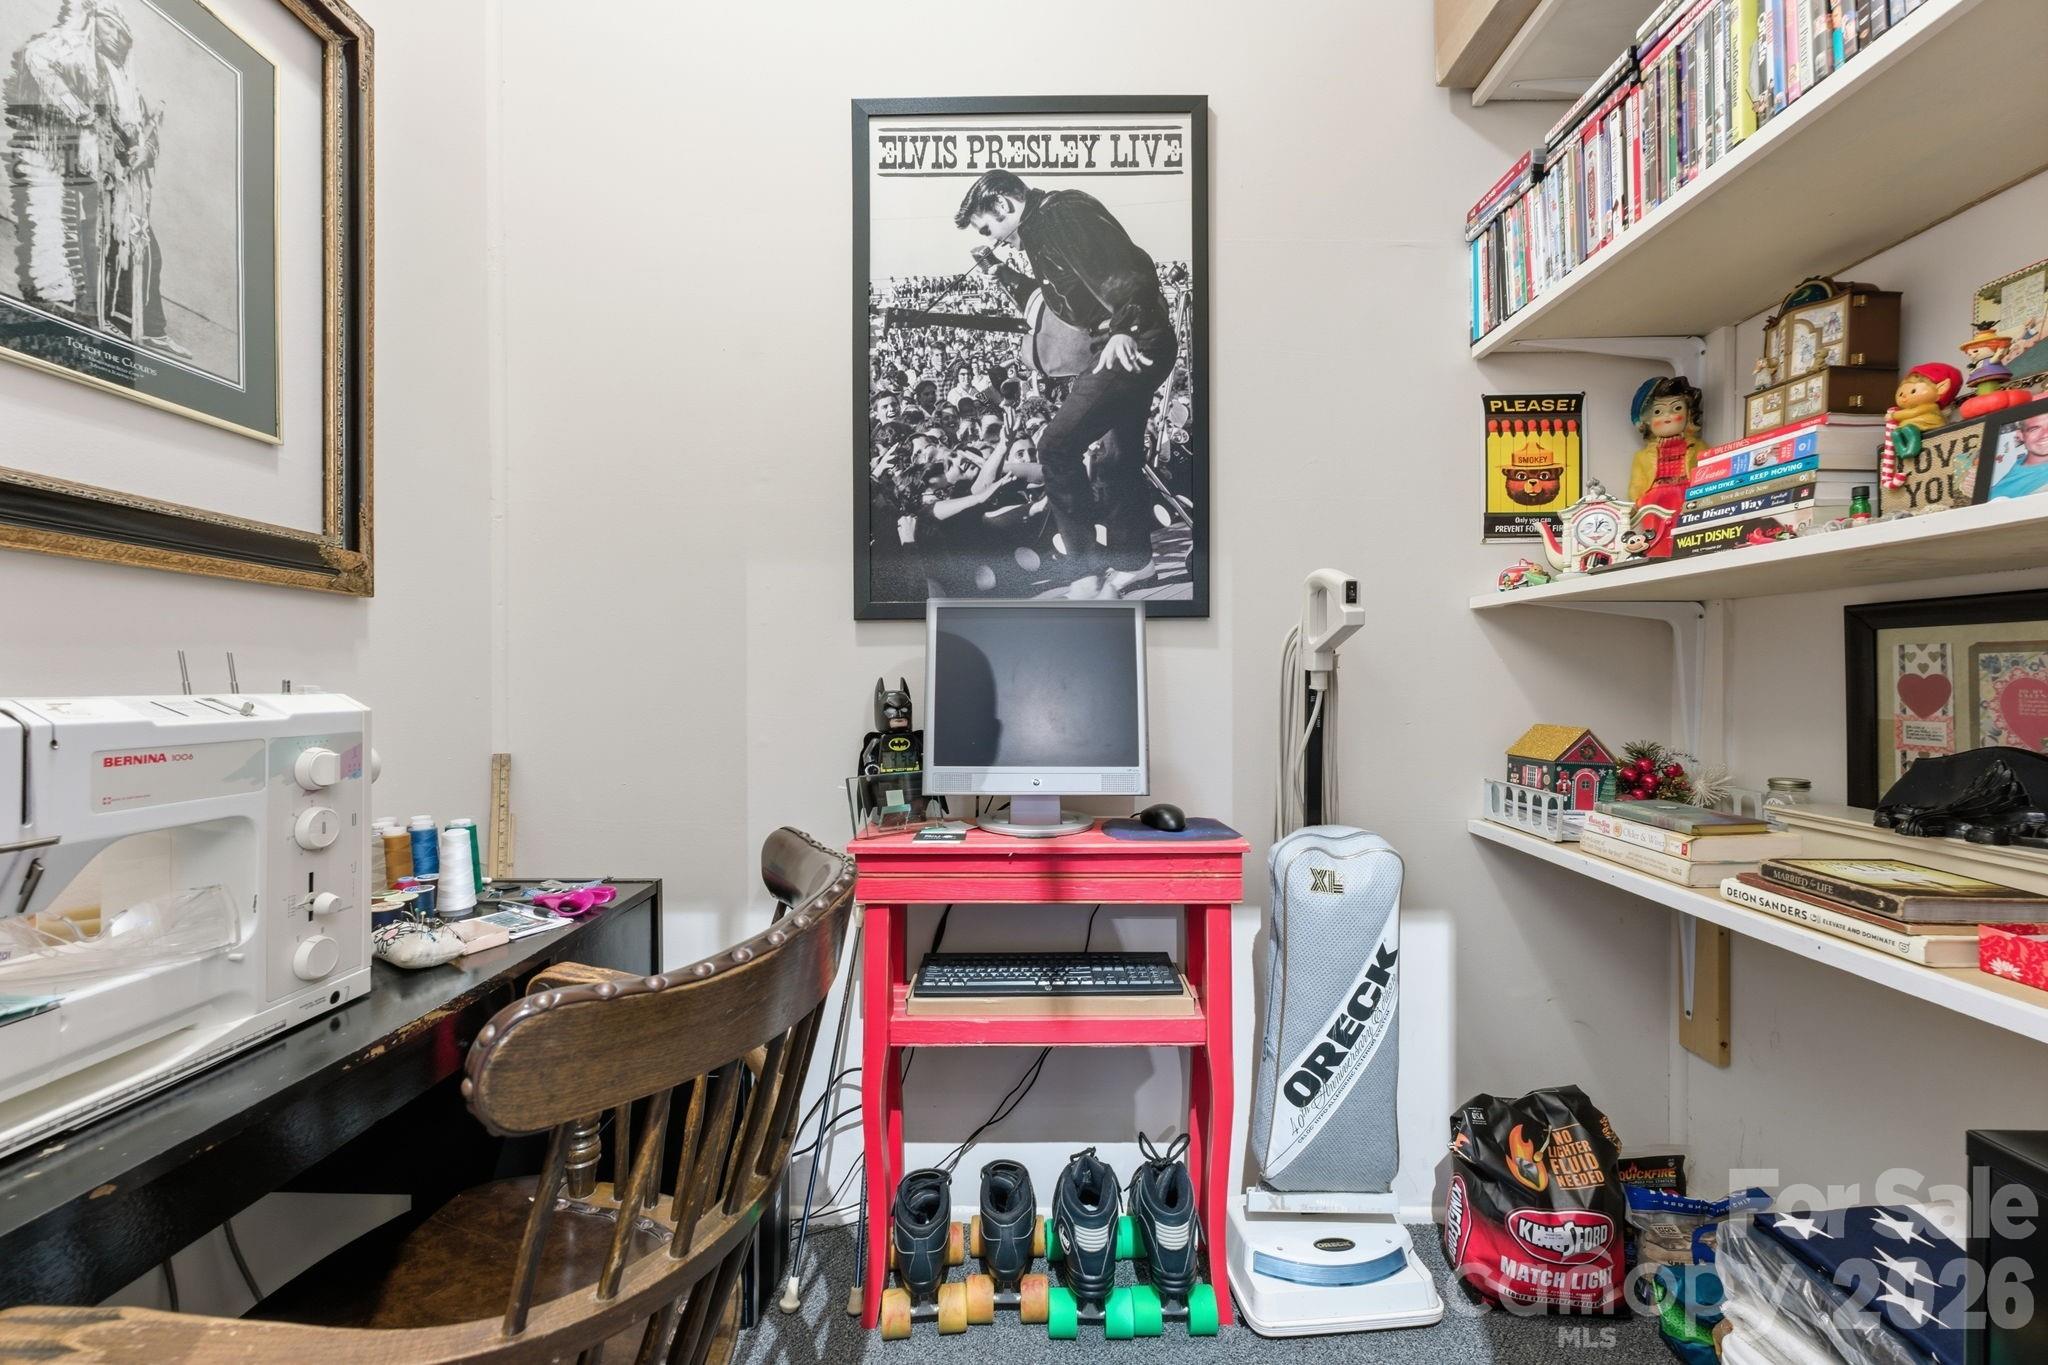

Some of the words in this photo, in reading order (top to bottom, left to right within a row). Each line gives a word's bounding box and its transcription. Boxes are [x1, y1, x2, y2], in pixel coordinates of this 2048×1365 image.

[878, 135, 958, 169] ELVIS
[966, 134, 1101, 169] PRESLEY
[1110, 133, 1183, 168] LIVE
[1490, 399, 1577, 413] PLEASE!
[1518, 456, 1548, 464] SMOKEY
[1689, 488, 1704, 497] DICK
[1718, 481, 1734, 490] DYKE
[1749, 472, 1769, 481] KEEP
[1771, 462, 1802, 476] MOVING
[1514, 516, 1528, 524] Only
[1681, 514, 1700, 523] The
[1702, 505, 1738, 520] Disney
[1741, 499, 1765, 511] Way
[1494, 525, 1524, 533] PREVENT
[1677, 533, 1704, 549] WALT
[1705, 525, 1744, 543] DISNEY
[103, 753, 167, 768] BERNINA
[1309, 866, 1344, 894] XL
[1773, 869, 1809, 887] MARRIED
[1816, 881, 1834, 895] LIFE
[1726, 886, 1757, 904] DEION
[1759, 896, 1808, 921] SANDERS
[1822, 918, 1847, 931] ELEVATE
[1847, 925, 1861, 936] AND
[1862, 930, 1896, 947] DOMINATE
[1283, 941, 1399, 1109] ORECK
[1311, 1025, 1374, 1111] Anniversary
[1553, 1130, 1573, 1144] NO
[1548, 1140, 1592, 1157] LIGHTER
[1551, 1154, 1600, 1175] FLUID
[1619, 1167, 1677, 1182] QUICKFIRE
[1556, 1170, 1605, 1189] NEEDED
[1268, 1195, 1290, 1210] XL
[1317, 1241, 1352, 1249] ORECK
[1518, 1219, 1608, 1256] KINGSFORD
[1500, 1256, 1565, 1288] MATCH
[1571, 1265, 1614, 1290] LIGHT
